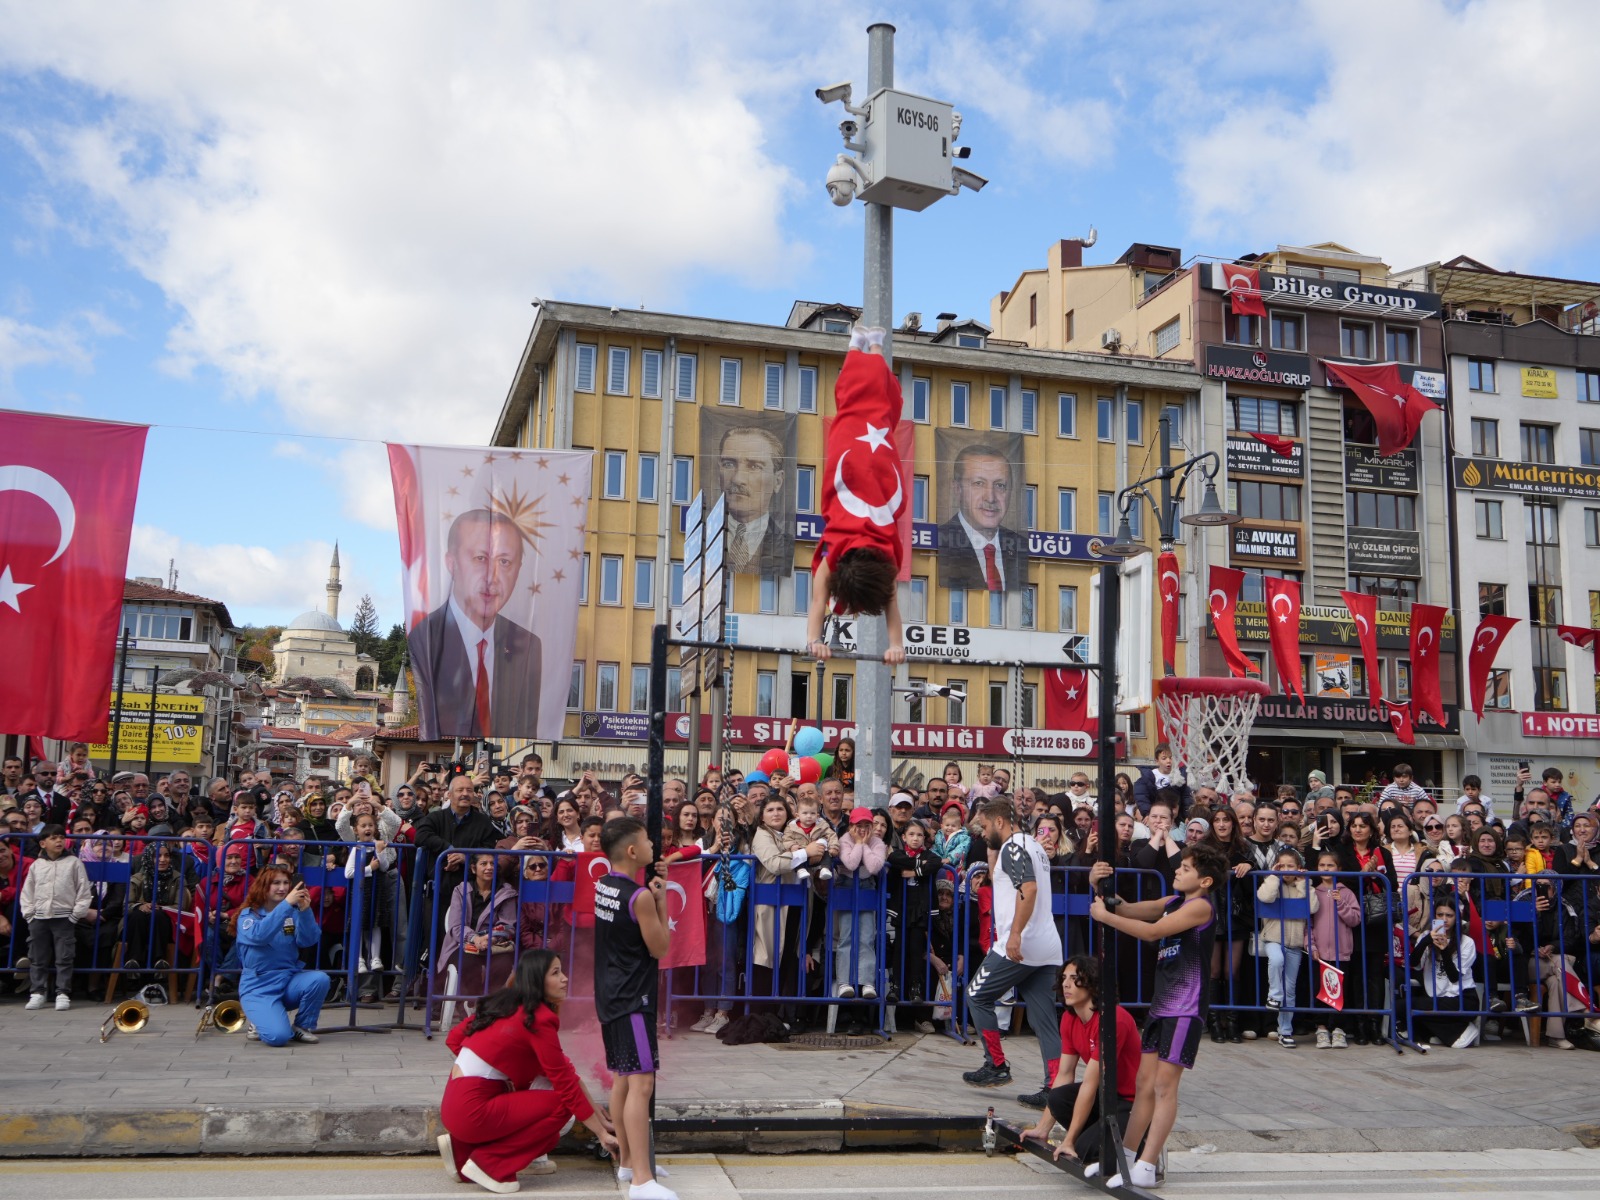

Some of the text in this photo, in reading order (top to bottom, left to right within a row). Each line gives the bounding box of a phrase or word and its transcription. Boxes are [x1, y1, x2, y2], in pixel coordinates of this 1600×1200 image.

[897, 107, 939, 132] KGYS-06
[1272, 276, 1417, 312] Bilge Group
[1227, 440, 1268, 453] AVUKATLIK
[1238, 463, 1271, 471] SEYFETTİN
[1509, 483, 1533, 491] EMLAK
[1541, 484, 1566, 494] İNŞAAT
[1251, 530, 1296, 545] AVUKAT
[1235, 543, 1271, 555] MUAMMER
[1362, 541, 1391, 552] ÖZLEM
[1525, 716, 1600, 732] 1. NOTE
[122, 730, 142, 738] Daire
[164, 725, 185, 740] 10
[1036, 736, 1054, 748] 212
[1055, 737, 1070, 749] 63
[1071, 738, 1086, 749] 66
[572, 760, 636, 773] pastırma
